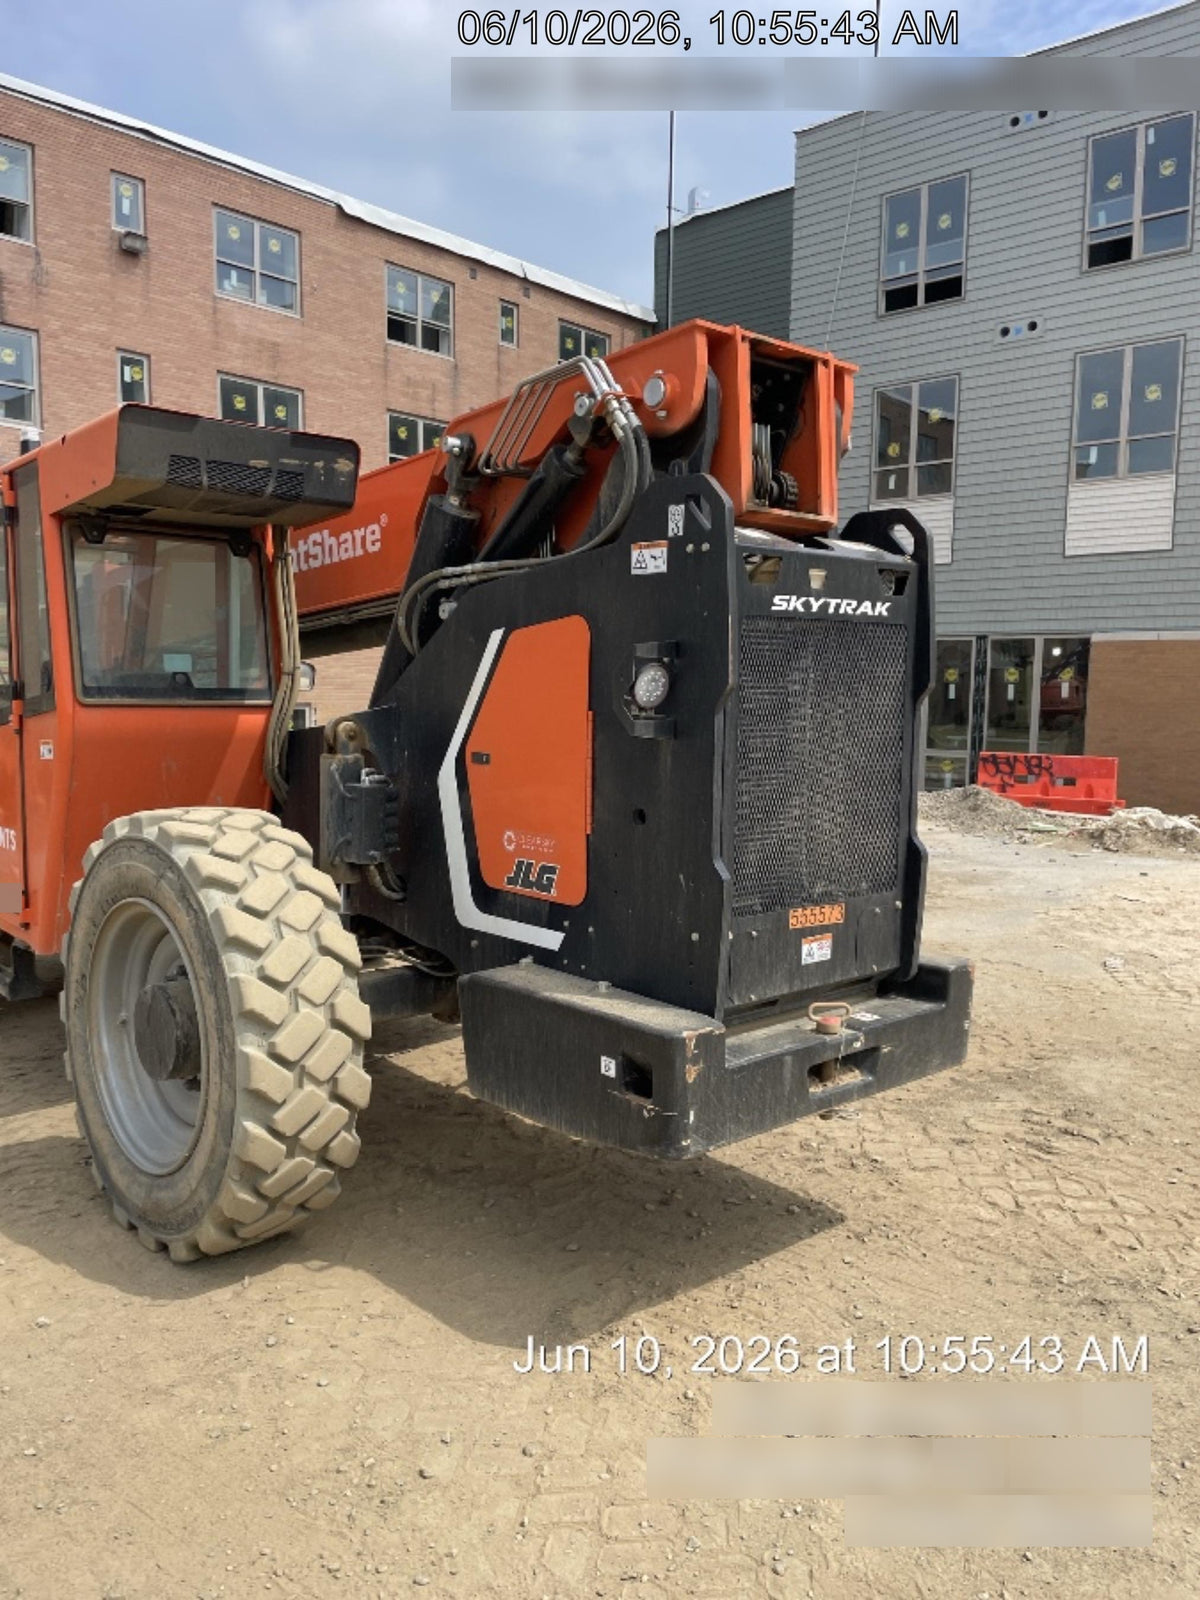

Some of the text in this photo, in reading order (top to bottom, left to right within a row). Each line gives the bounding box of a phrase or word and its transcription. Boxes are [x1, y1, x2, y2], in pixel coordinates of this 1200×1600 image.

[771, 595, 892, 616] SKYTRAK
[504, 858, 560, 896] JLG
[790, 903, 844, 927] 555573
